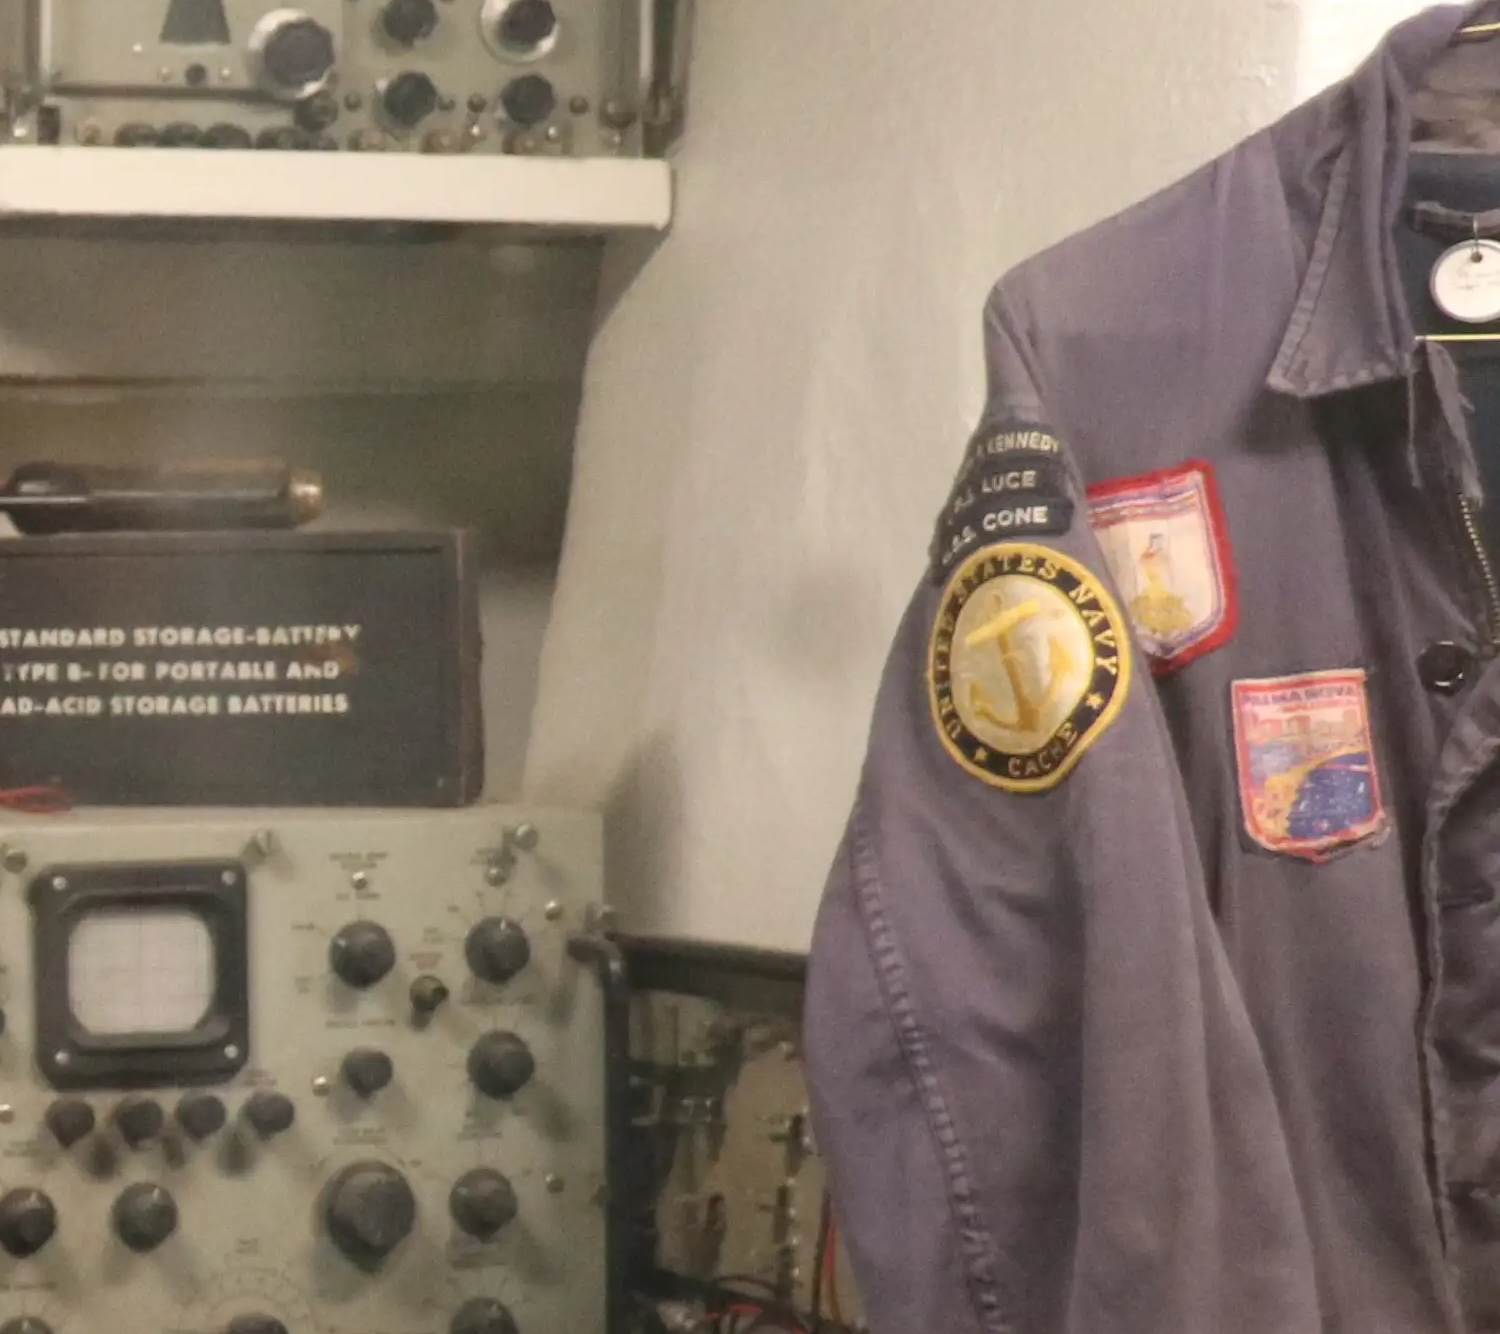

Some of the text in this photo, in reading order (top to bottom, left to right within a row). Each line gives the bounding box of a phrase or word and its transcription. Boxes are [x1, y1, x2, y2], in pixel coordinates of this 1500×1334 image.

[986, 430, 1061, 455] KENNEDY
[981, 469, 1037, 494] LUCE
[982, 505, 1050, 533] CONE
[132, 623, 362, 648] STORAGE-BATTERY
[1067, 581, 1119, 677] NAVY
[98, 661, 146, 682] FOR
[154, 660, 277, 682] PORTABLE
[285, 660, 340, 681] AND
[109, 694, 219, 716] STORAGE
[227, 693, 350, 716] BATTERIES
